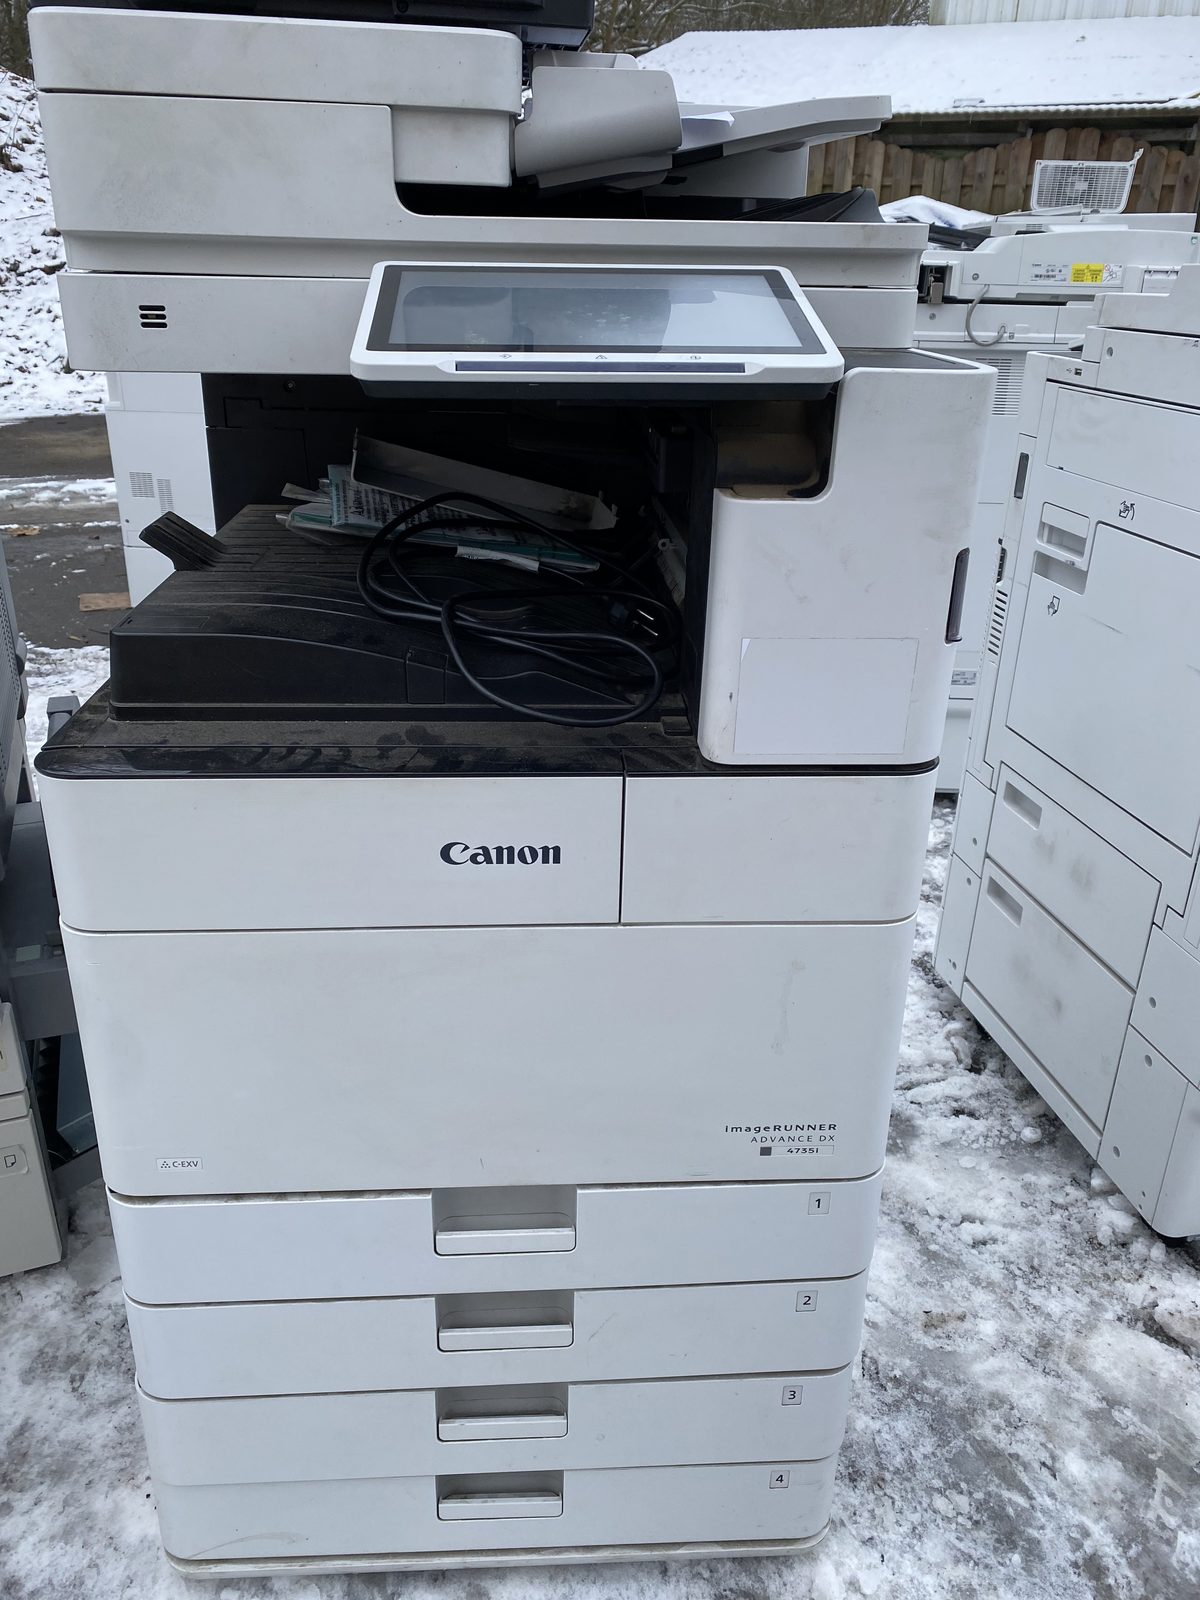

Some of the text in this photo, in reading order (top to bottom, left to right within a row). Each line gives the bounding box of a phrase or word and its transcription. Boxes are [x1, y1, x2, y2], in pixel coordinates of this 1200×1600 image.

[440, 842, 561, 865] Canon
[725, 1124, 837, 1133] imageRUNNER
[751, 1135, 813, 1143] ADVANCE
[815, 1198, 821, 1209] 1
[802, 1295, 812, 1306] 2
[788, 1390, 797, 1400] 3
[775, 1474, 784, 1484] 4
